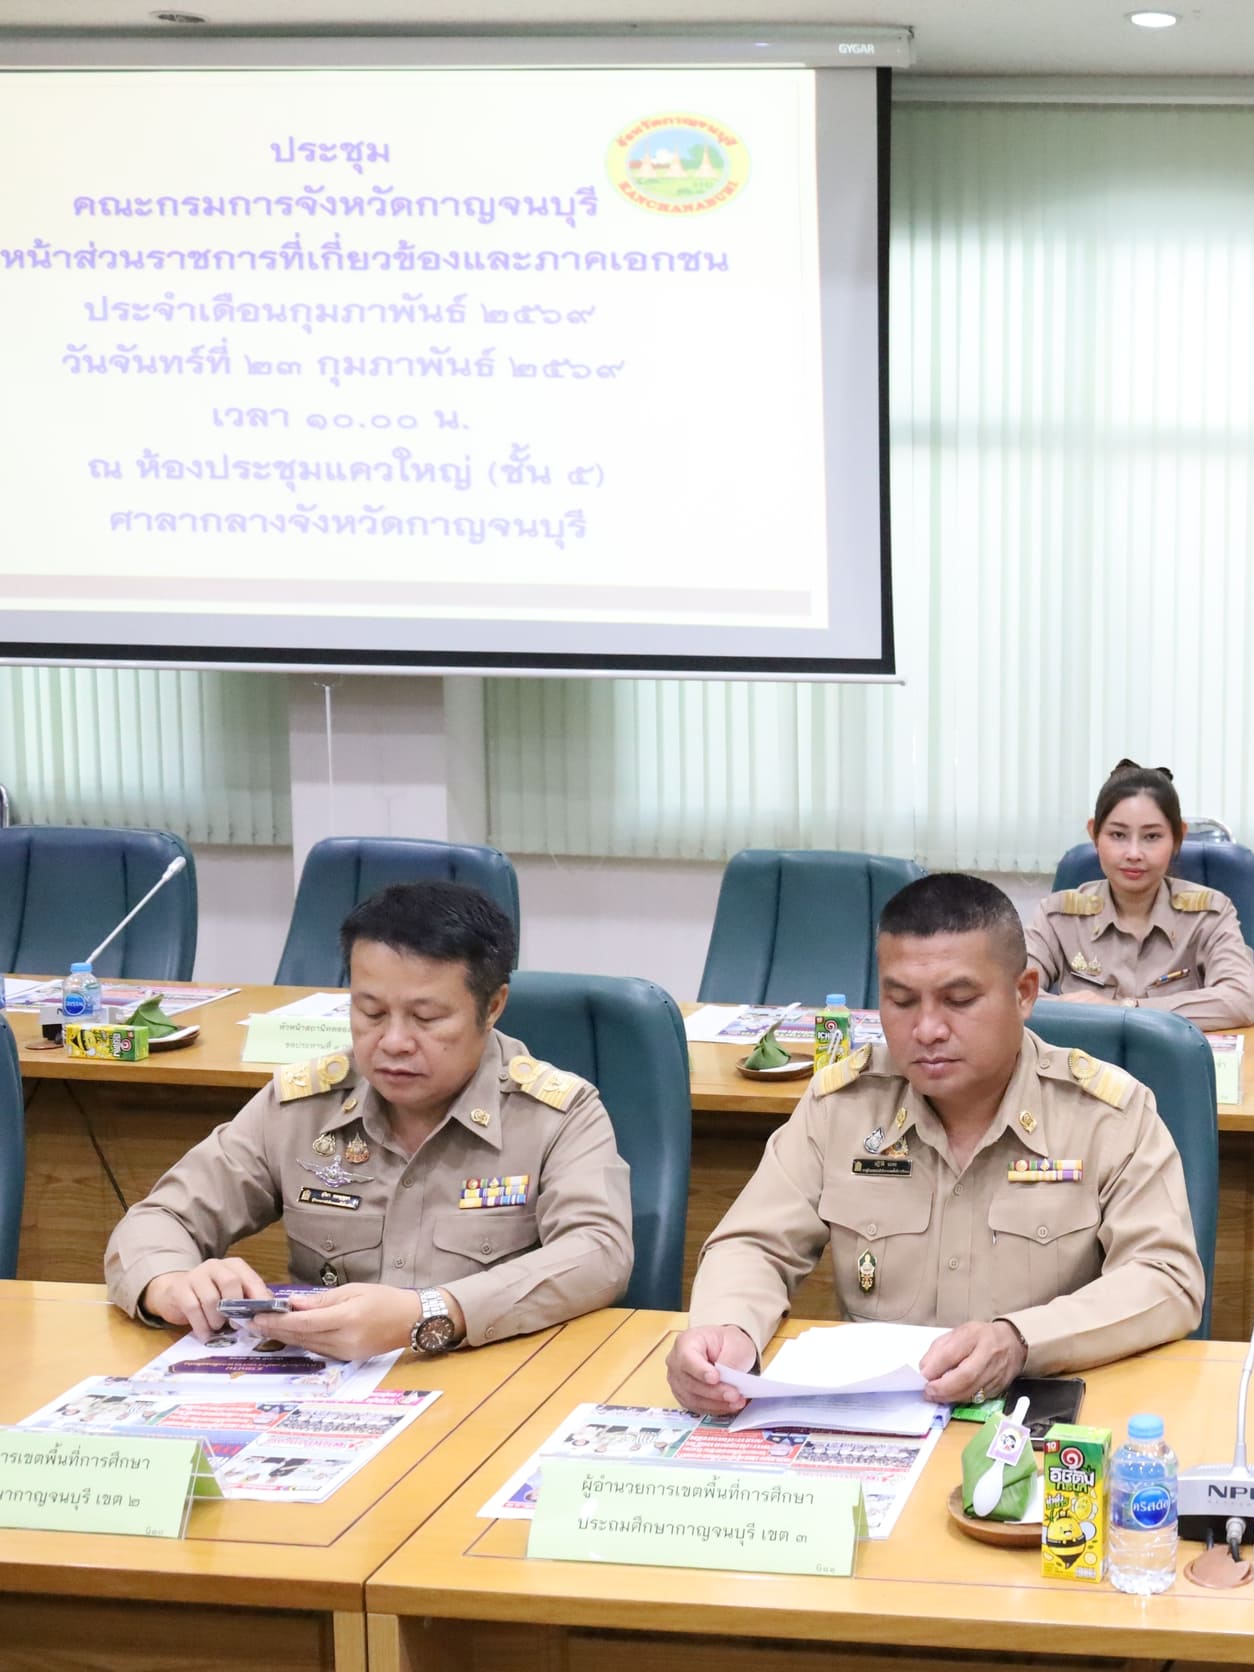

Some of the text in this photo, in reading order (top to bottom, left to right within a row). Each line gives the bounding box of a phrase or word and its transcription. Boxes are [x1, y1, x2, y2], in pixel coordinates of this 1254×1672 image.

[838, 43, 875, 54] GYGAR
[270, 136, 390, 174] ประชุม
[73, 184, 598, 228] คณะกรมการจังหวัดกาญจนบุรี
[84, 291, 596, 334] ประจำเดือนกุมภาพันธ์ ๒๕๖๙
[62, 337, 625, 388] วันจันทร์ที่ ๒๓ กุมภาพันธ์ ๒๕๖๙
[212, 407, 289, 429] เวลา
[87, 458, 122, 480] ณ
[135, 447, 472, 491] ห้องประชุมแควใหญ่
[487, 442, 551, 486] (ชั้น
[109, 503, 587, 550] ศาลากลางจังหวัดกาญจนบุรี
[95, 1493, 124, 1507] เขต
[127, 1495, 141, 1508] ๒
[581, 1474, 815, 1505] ผู้อำนวยการเขตพื้นที่การศึกษา
[577, 1515, 808, 1548] ประถมศึกษากาญจนบุรี เขต ๓
